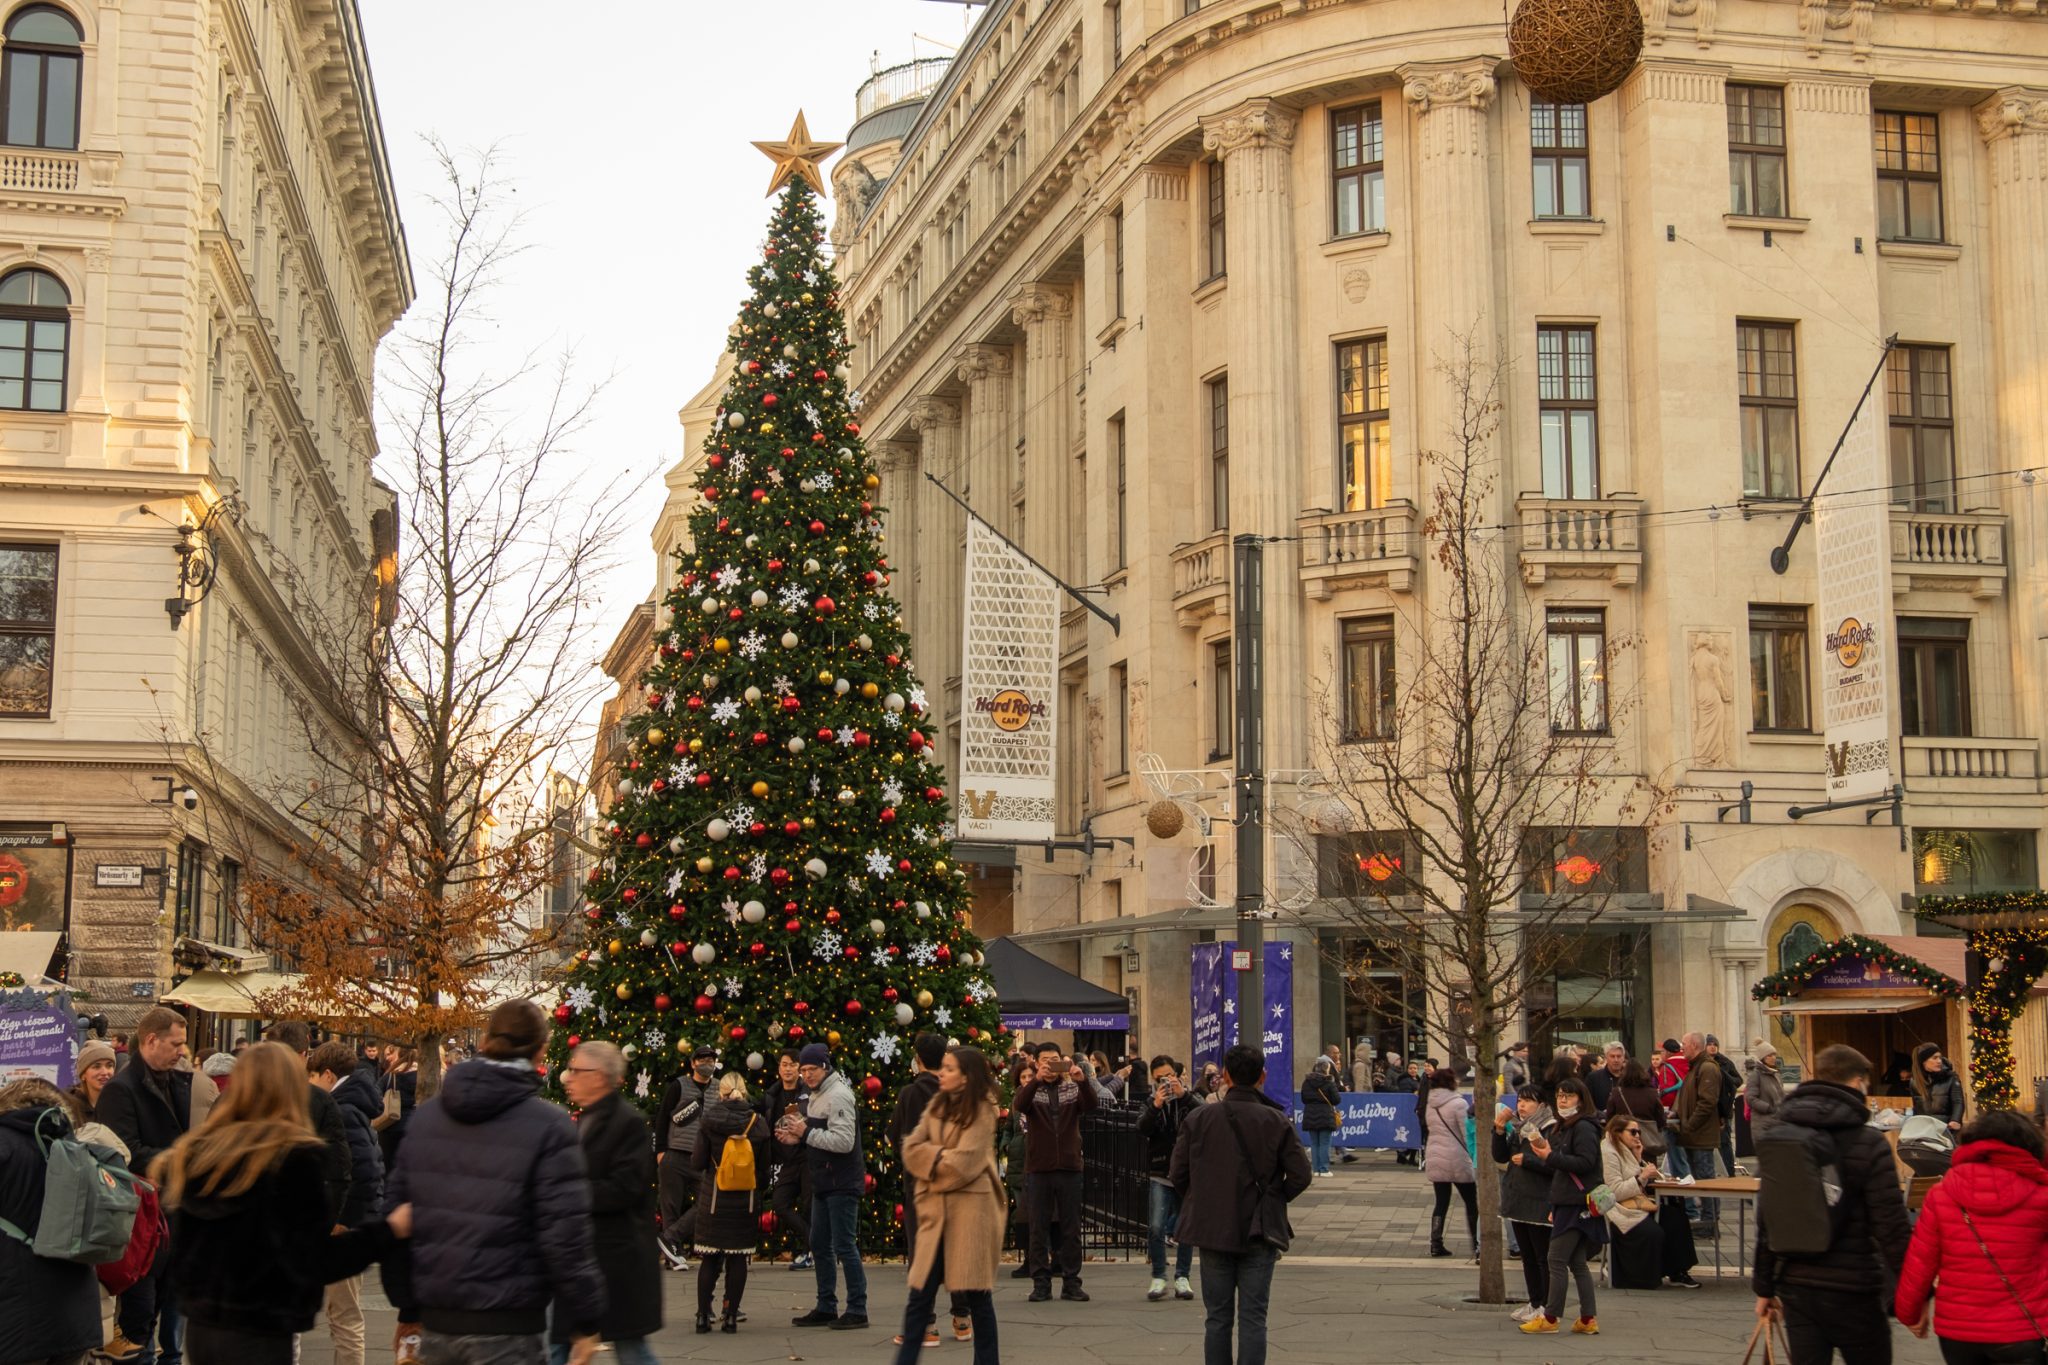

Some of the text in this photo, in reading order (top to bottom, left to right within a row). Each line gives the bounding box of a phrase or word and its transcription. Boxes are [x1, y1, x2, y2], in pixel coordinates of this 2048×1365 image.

[1826, 622, 1875, 652] Hard Rock
[1844, 650, 1858, 660] CAFE
[1839, 673, 1863, 686] BUDAPEST
[975, 696, 1046, 717] Hard Rock
[1002, 717, 1020, 725] CAFE
[992, 737, 1028, 745] BUDAPEST
[967, 821, 988, 830] VÁCI
[30, 836, 47, 844] bar
[1888, 974, 1902, 984] Top
[1004, 1018, 1114, 1029] nnepeket! Happy Holidays!
[1262, 1030, 1283, 1045] iday
[3, 1038, 36, 1053] part of
[32, 1042, 64, 1057] magic!
[1294, 1109, 1304, 1124] Ta
[1348, 1102, 1397, 1121] holiday
[1341, 1120, 1370, 1140] you!
